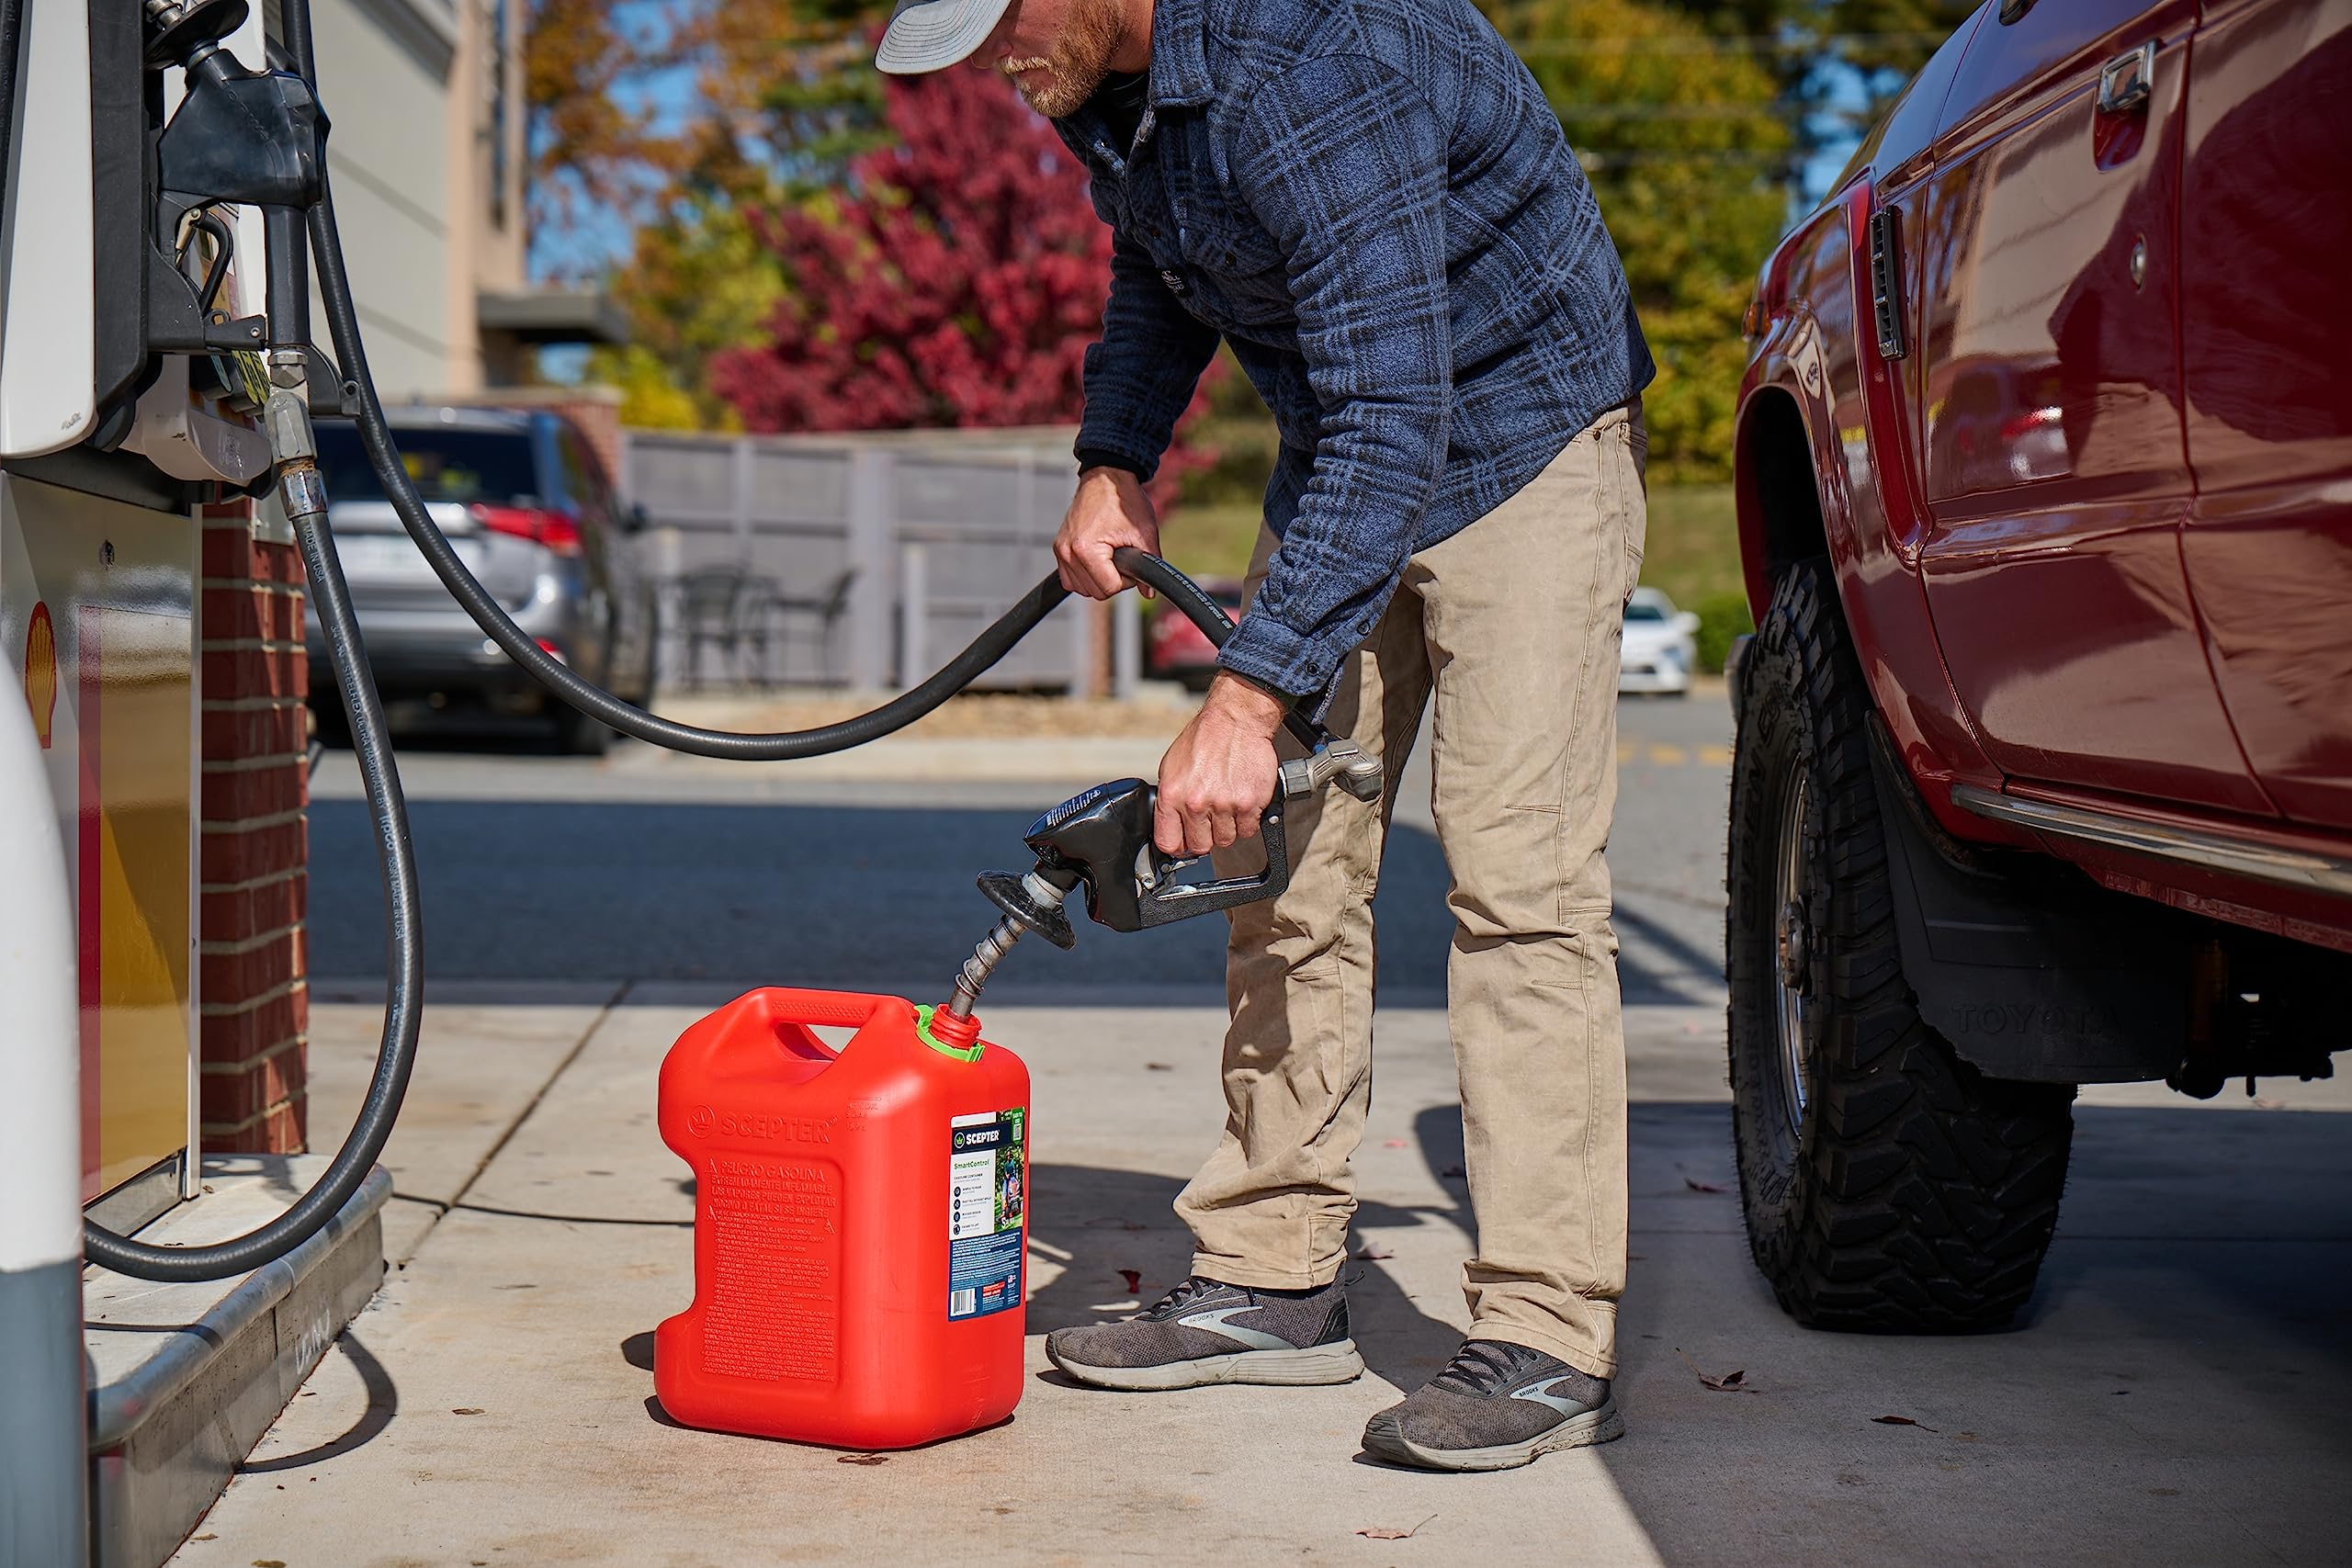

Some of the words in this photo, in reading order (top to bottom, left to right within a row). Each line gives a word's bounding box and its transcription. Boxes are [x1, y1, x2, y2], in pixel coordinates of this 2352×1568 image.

[312, 562, 324, 583] USA
[391, 880, 401, 908] MADE
[395, 919, 405, 941] USA
[1950, 1004, 2125, 1035] TOYOTA
[719, 1110, 831, 1144] SCEPTER
[966, 1130, 1000, 1145] SCEPTER
[721, 1161, 765, 1177] PELIGRO
[766, 1166, 825, 1182] GASOLINA
[954, 1159, 989, 1170] SmartControl
[1519, 1386, 1539, 1397] BROOKS
